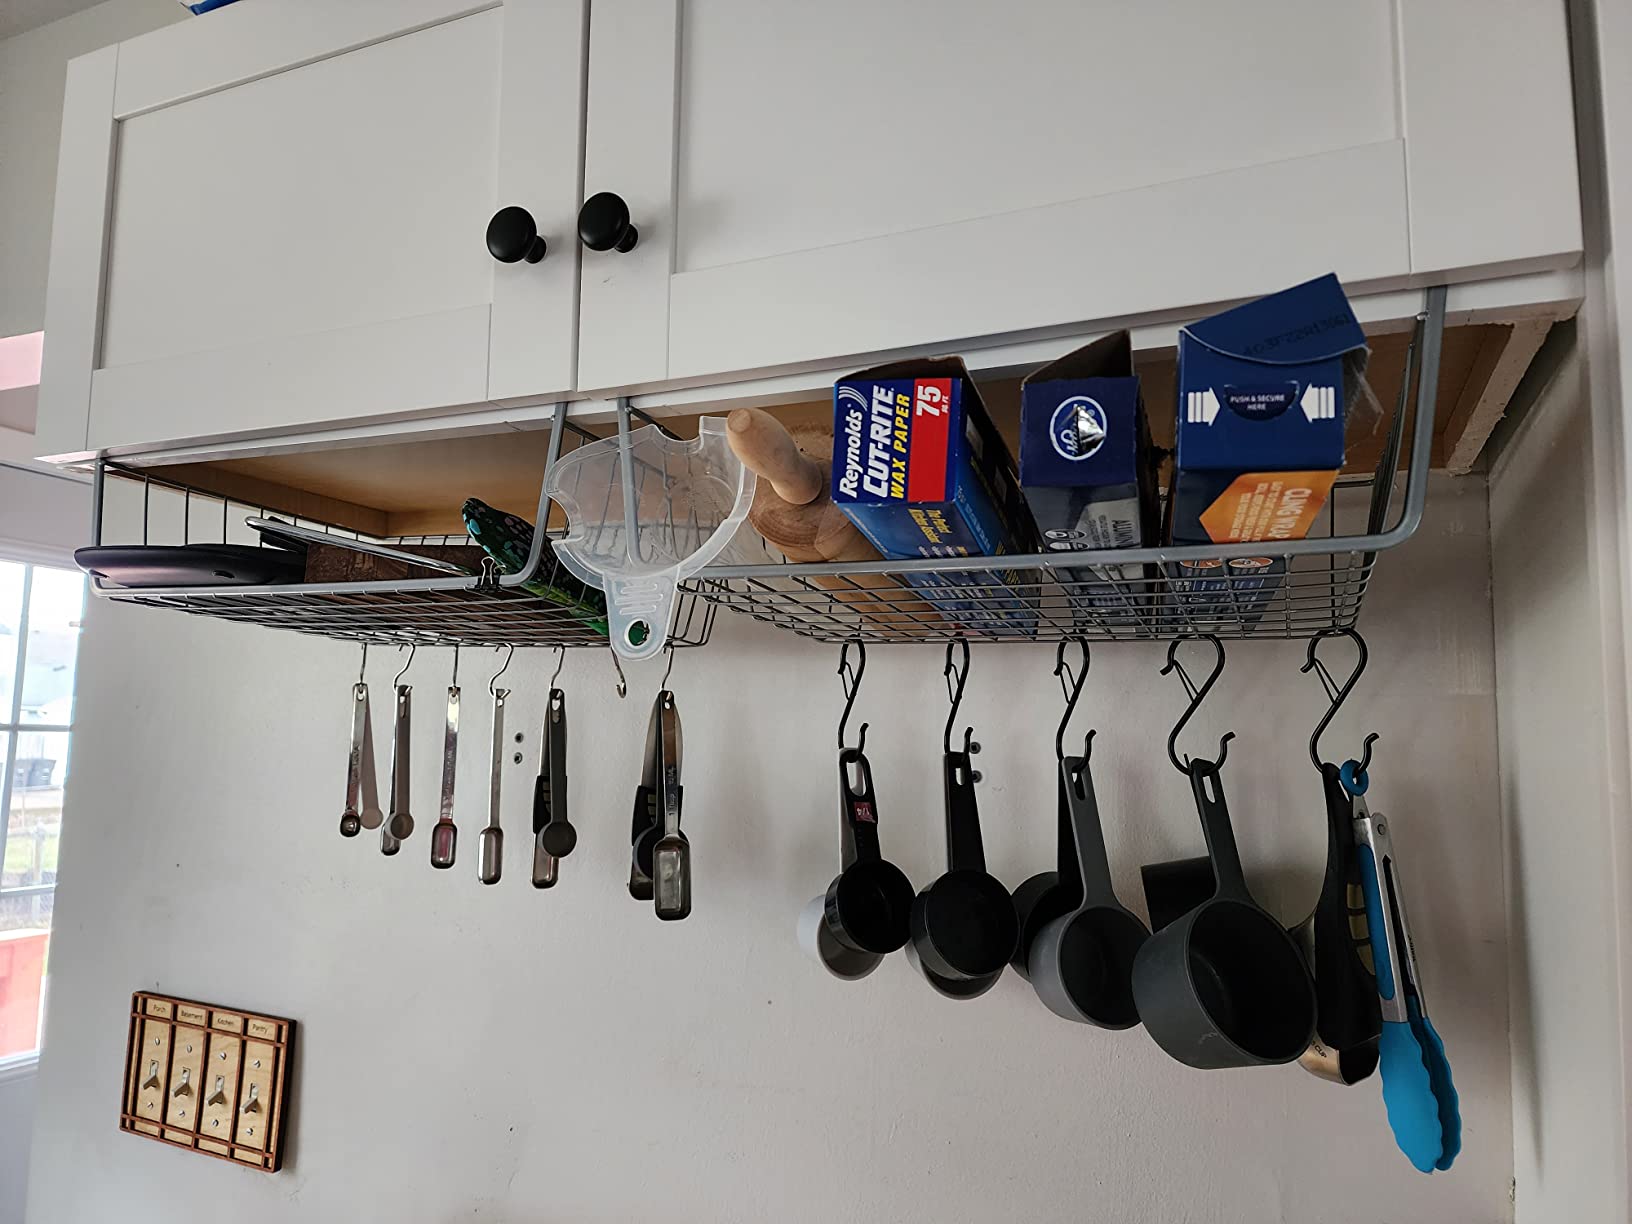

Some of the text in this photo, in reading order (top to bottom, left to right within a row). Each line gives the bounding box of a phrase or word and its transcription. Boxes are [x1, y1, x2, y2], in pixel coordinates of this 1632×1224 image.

[916, 385, 942, 416] 75
[1230, 395, 1250, 403] PUSH
[1257, 394, 1285, 402] SECURE
[1247, 403, 1266, 411] HERE
[863, 385, 894, 498] CUT-RITE
[891, 394, 911, 499] WAX PAPER
[839, 409, 864, 499] Reynolds
[180, 1010, 203, 1019] Basement
[252, 1023, 268, 1034] Pantry
